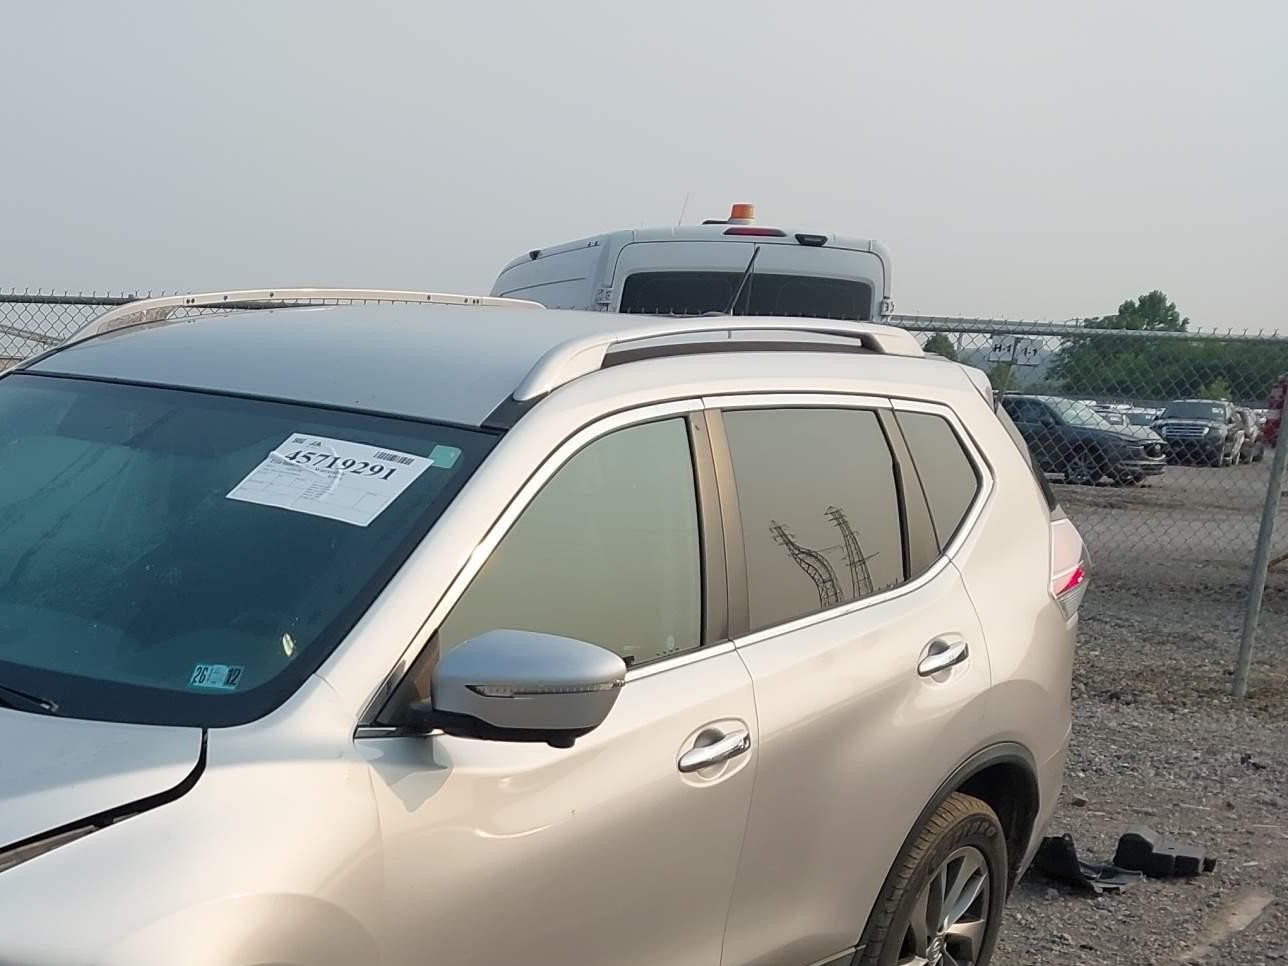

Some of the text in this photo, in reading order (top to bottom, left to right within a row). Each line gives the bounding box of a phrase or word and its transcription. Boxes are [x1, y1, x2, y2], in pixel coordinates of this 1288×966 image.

[285, 449, 397, 481] 45719291
[192, 666, 242, 687] 26 12
